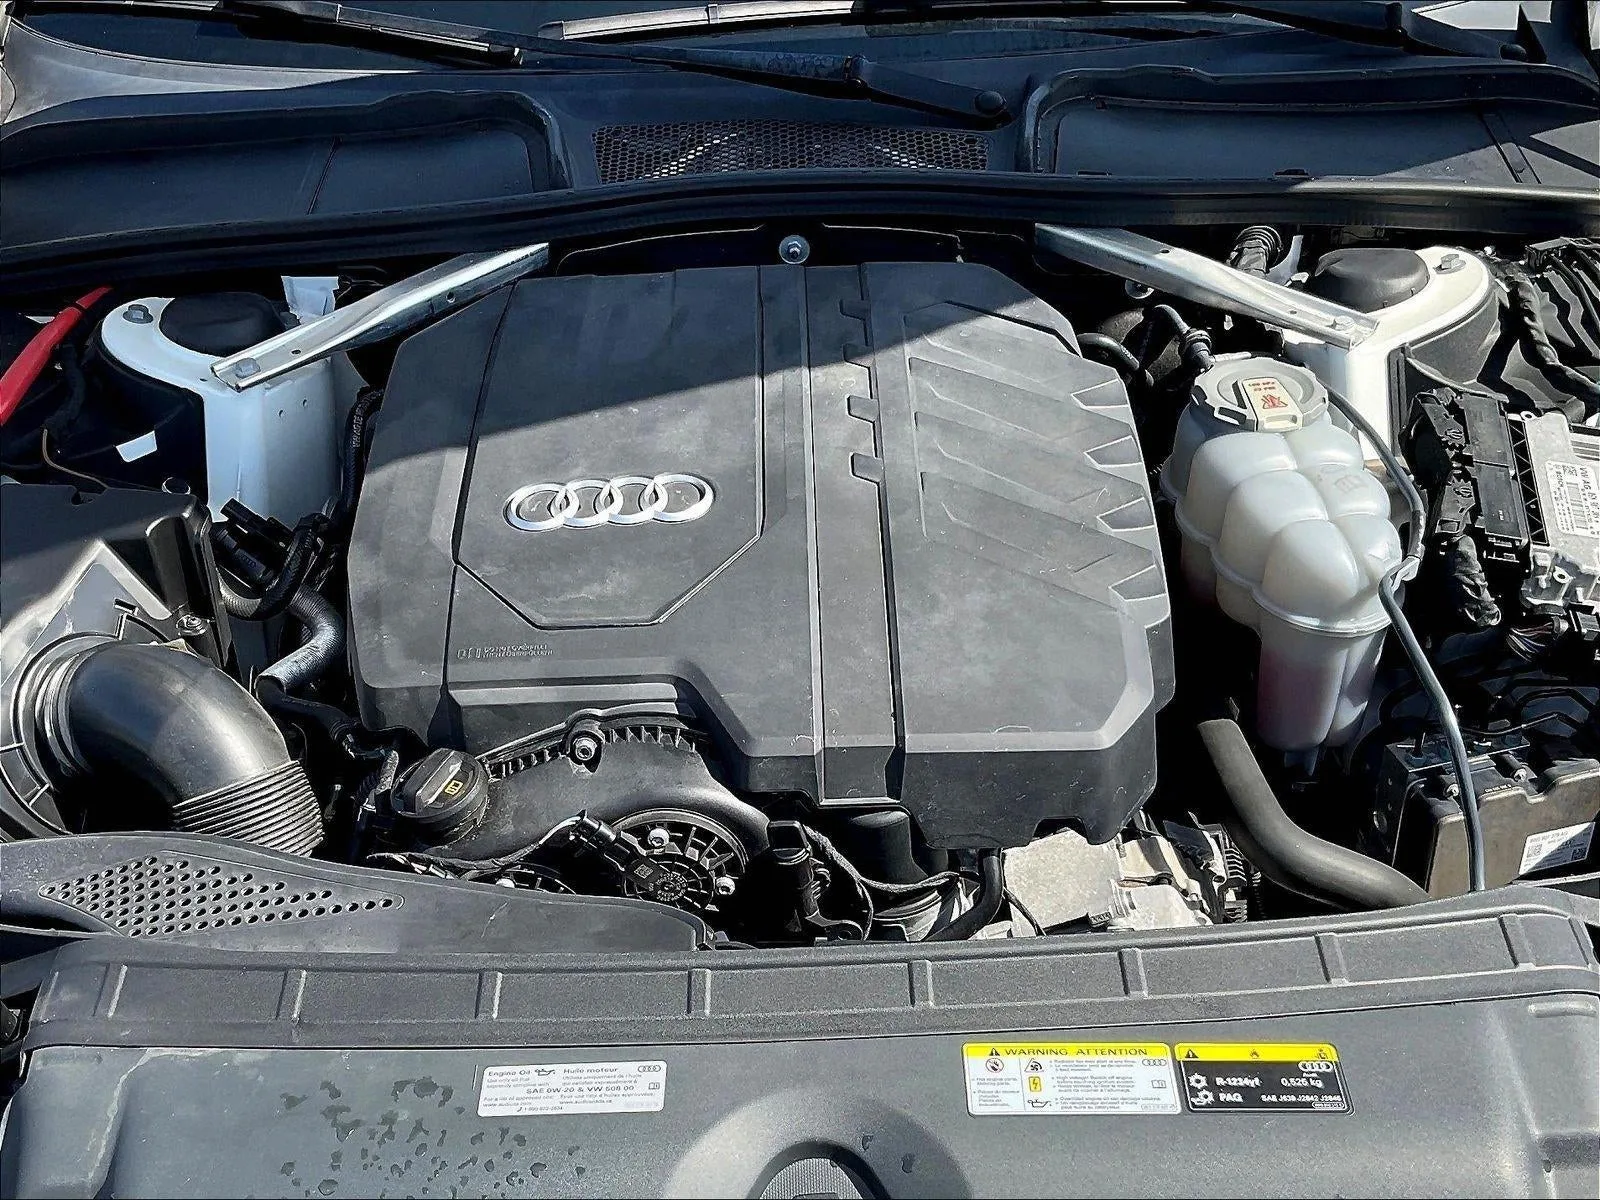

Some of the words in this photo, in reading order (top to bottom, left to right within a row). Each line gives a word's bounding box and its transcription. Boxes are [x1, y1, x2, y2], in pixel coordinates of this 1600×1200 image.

[1582, 479, 1592, 490] AG
[1005, 1048, 1068, 1056] WARNING
[1075, 1048, 1148, 1056] ATTENTION
[1310, 1077, 1323, 1088] kg
[1219, 1093, 1243, 1102] PAG
